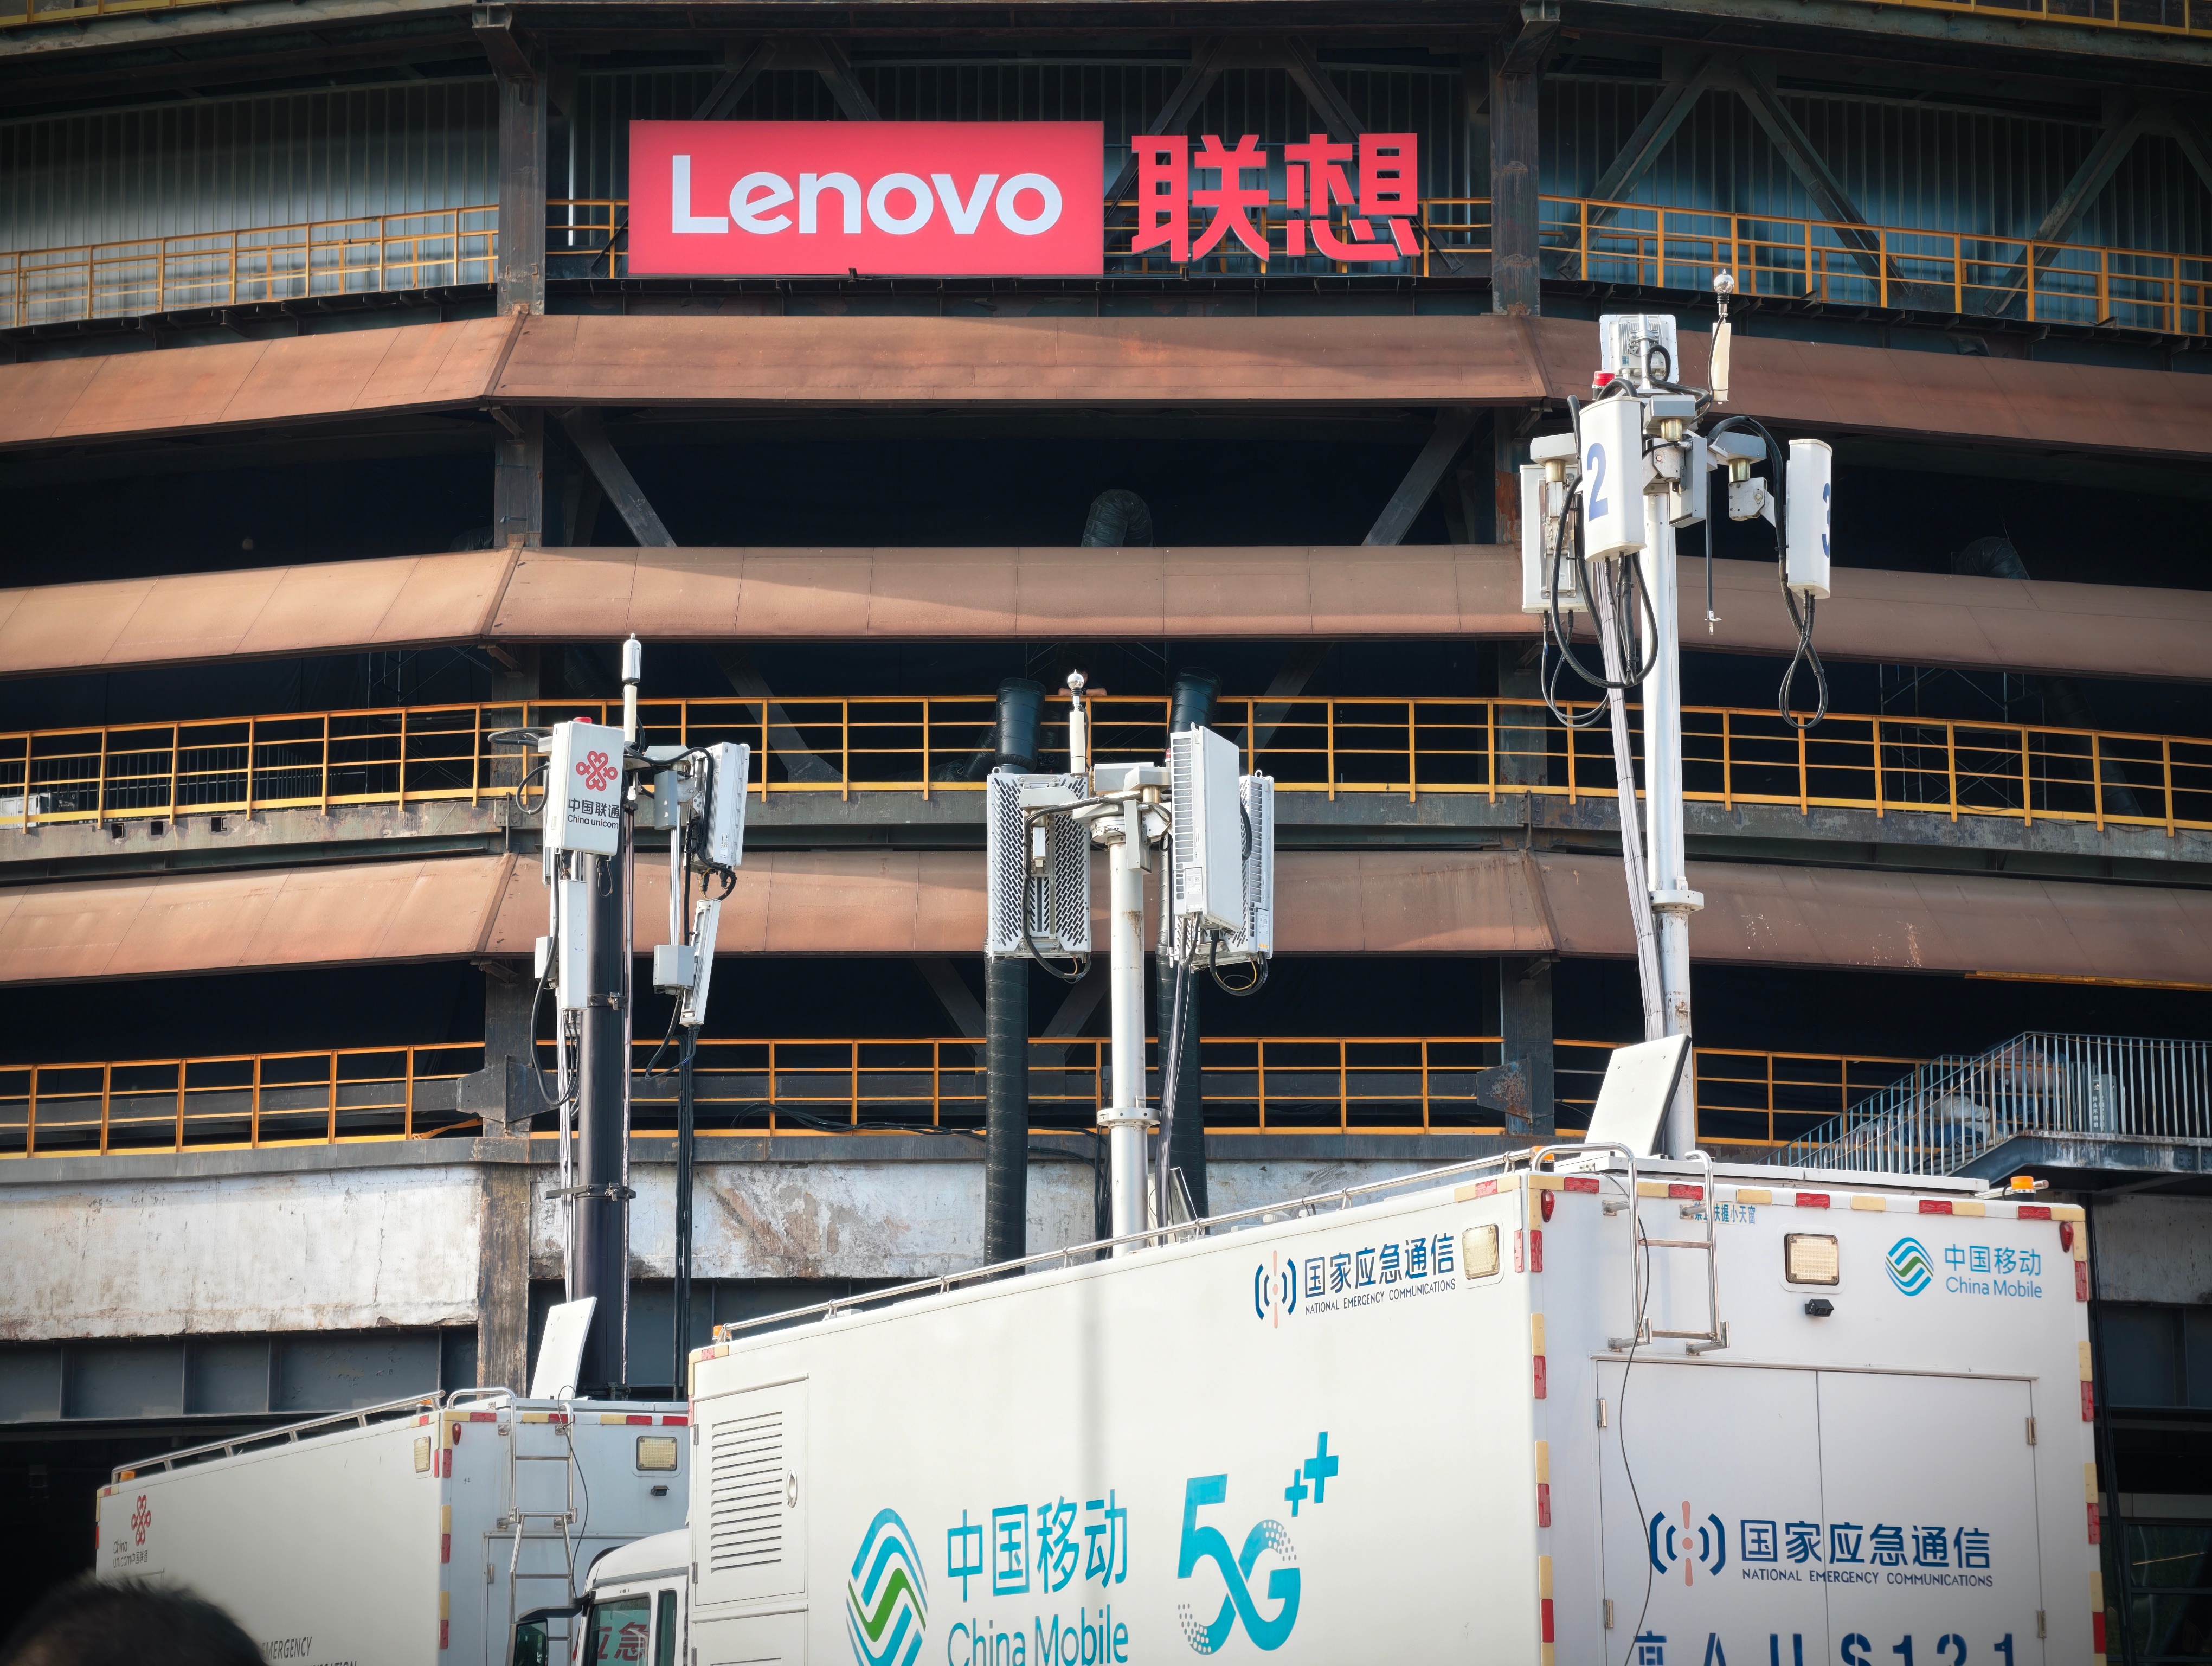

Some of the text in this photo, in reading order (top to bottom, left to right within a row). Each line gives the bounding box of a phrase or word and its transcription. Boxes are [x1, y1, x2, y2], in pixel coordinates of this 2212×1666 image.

[672, 155, 1063, 235] Lenovo
[1131, 133, 1420, 262] 联想
[1586, 442, 1609, 522] 2
[1822, 483, 1830, 558] 3
[567, 814, 619, 829] China unicom
[568, 798, 619, 819] 中国联通
[1304, 1233, 1454, 1298] 国家应急通信
[1945, 1244, 2042, 1277] 中国移动
[1305, 1278, 1456, 1315] NATIONAL EMERGENCY COMMUNICATIONS
[1946, 1276, 2043, 1299] China Mobile
[113, 1539, 128, 1554] China
[947, 1489, 1128, 1603] 中国移动
[1740, 1519, 1990, 1569] 国家应急通信
[1742, 1569, 1993, 1587] NATIONAL EMERGENCY COMMUNICATIONS
[948, 1604, 1129, 1666] China Mobile
